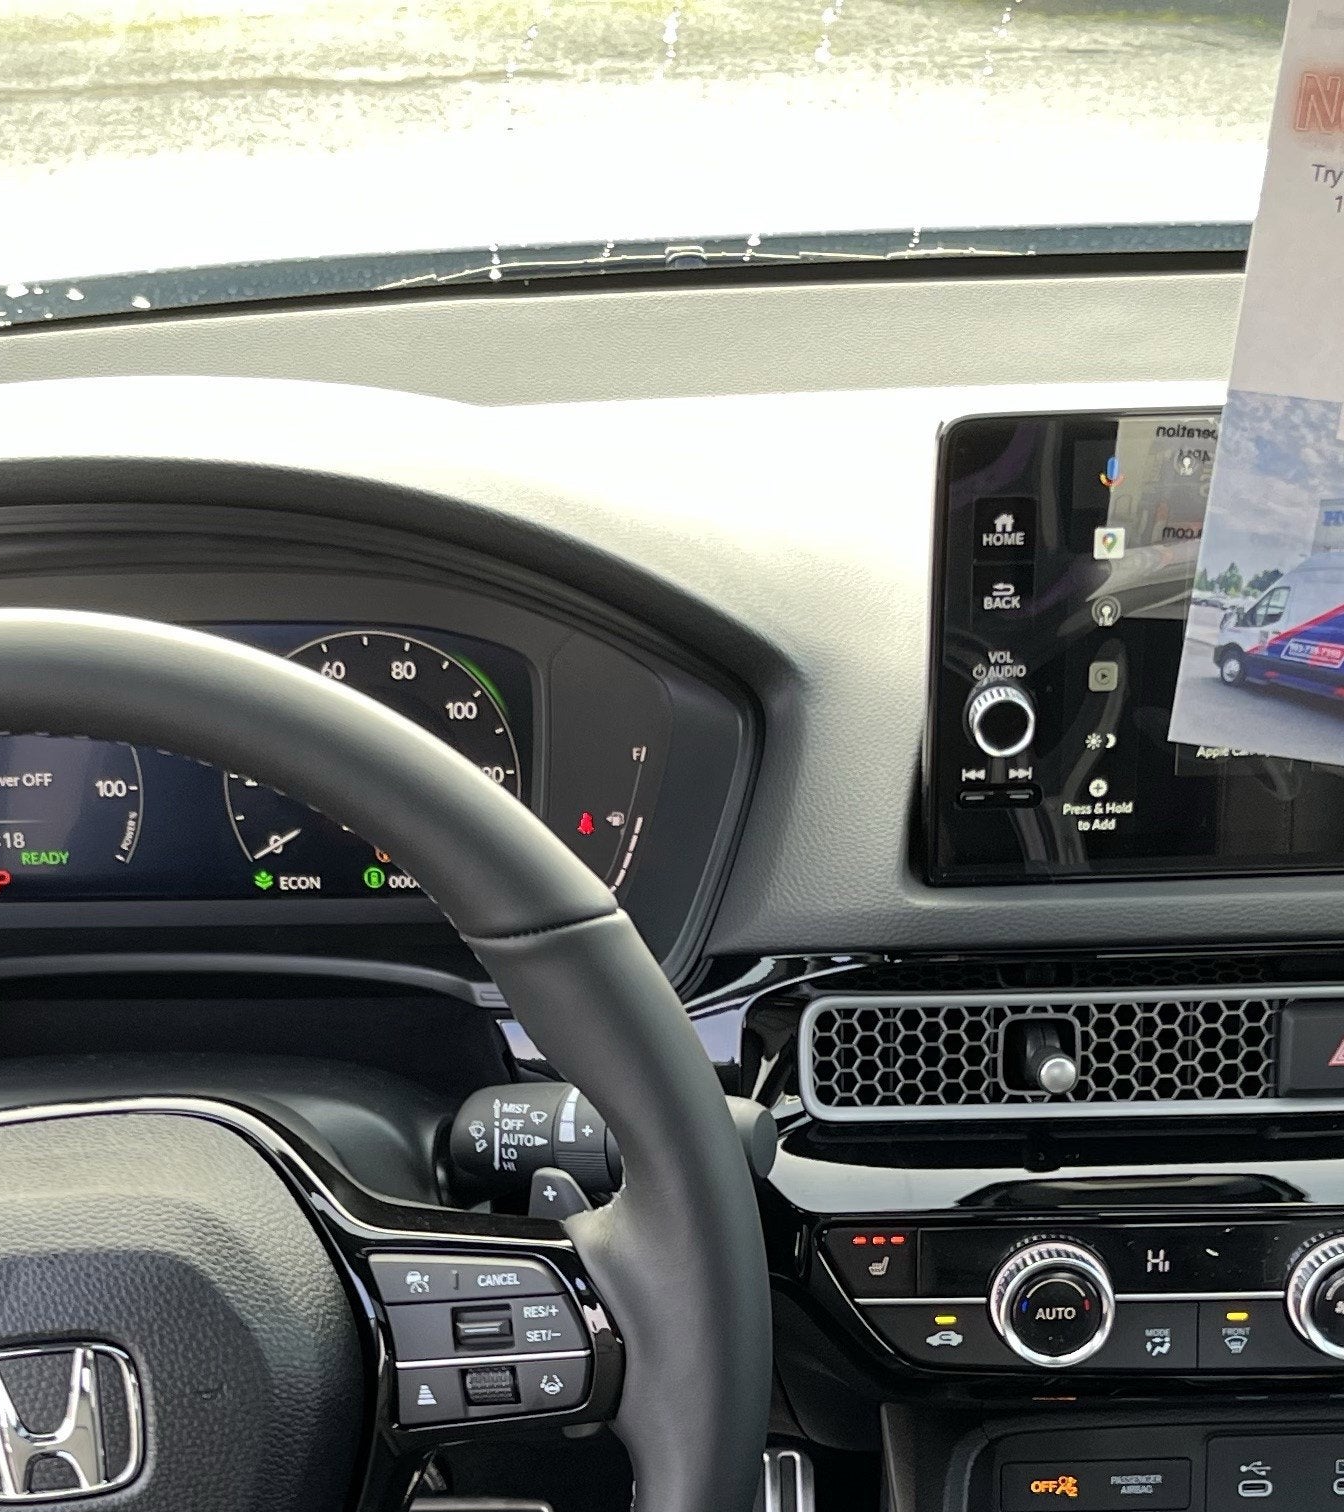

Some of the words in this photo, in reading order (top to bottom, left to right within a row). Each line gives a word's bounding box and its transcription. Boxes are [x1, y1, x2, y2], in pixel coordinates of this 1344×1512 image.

[1312, 164, 1343, 187] Try
[982, 532, 1025, 546] HOME
[983, 596, 1020, 610] BACK
[988, 651, 1014, 664] VOL
[320, 661, 346, 680] 60
[390, 661, 416, 680] 80
[987, 665, 1027, 678] AUDIO
[445, 702, 477, 719] 100
[22, 773, 53, 787] OFF
[95, 780, 127, 797] 100
[1062, 802, 1092, 815] Press
[1094, 802, 1103, 814] &
[1105, 801, 1133, 814] Hold
[1078, 819, 1090, 831] to
[1092, 818, 1116, 830] Add
[21, 851, 69, 865] READY
[279, 876, 321, 890] ECON
[388, 875, 420, 888] 000
[502, 1103, 531, 1114] MIST
[501, 1118, 525, 1130] OFF
[501, 1133, 534, 1146] AUTO
[501, 1148, 518, 1160] LO
[477, 1273, 521, 1286] CANCEL
[1035, 1307, 1076, 1321] AUTO
[1144, 1328, 1171, 1337] MODE
[1110, 1475, 1162, 1484] PASSENGER
[1030, 1480, 1058, 1493] OFF
[1120, 1485, 1153, 1494] AIRBAG
